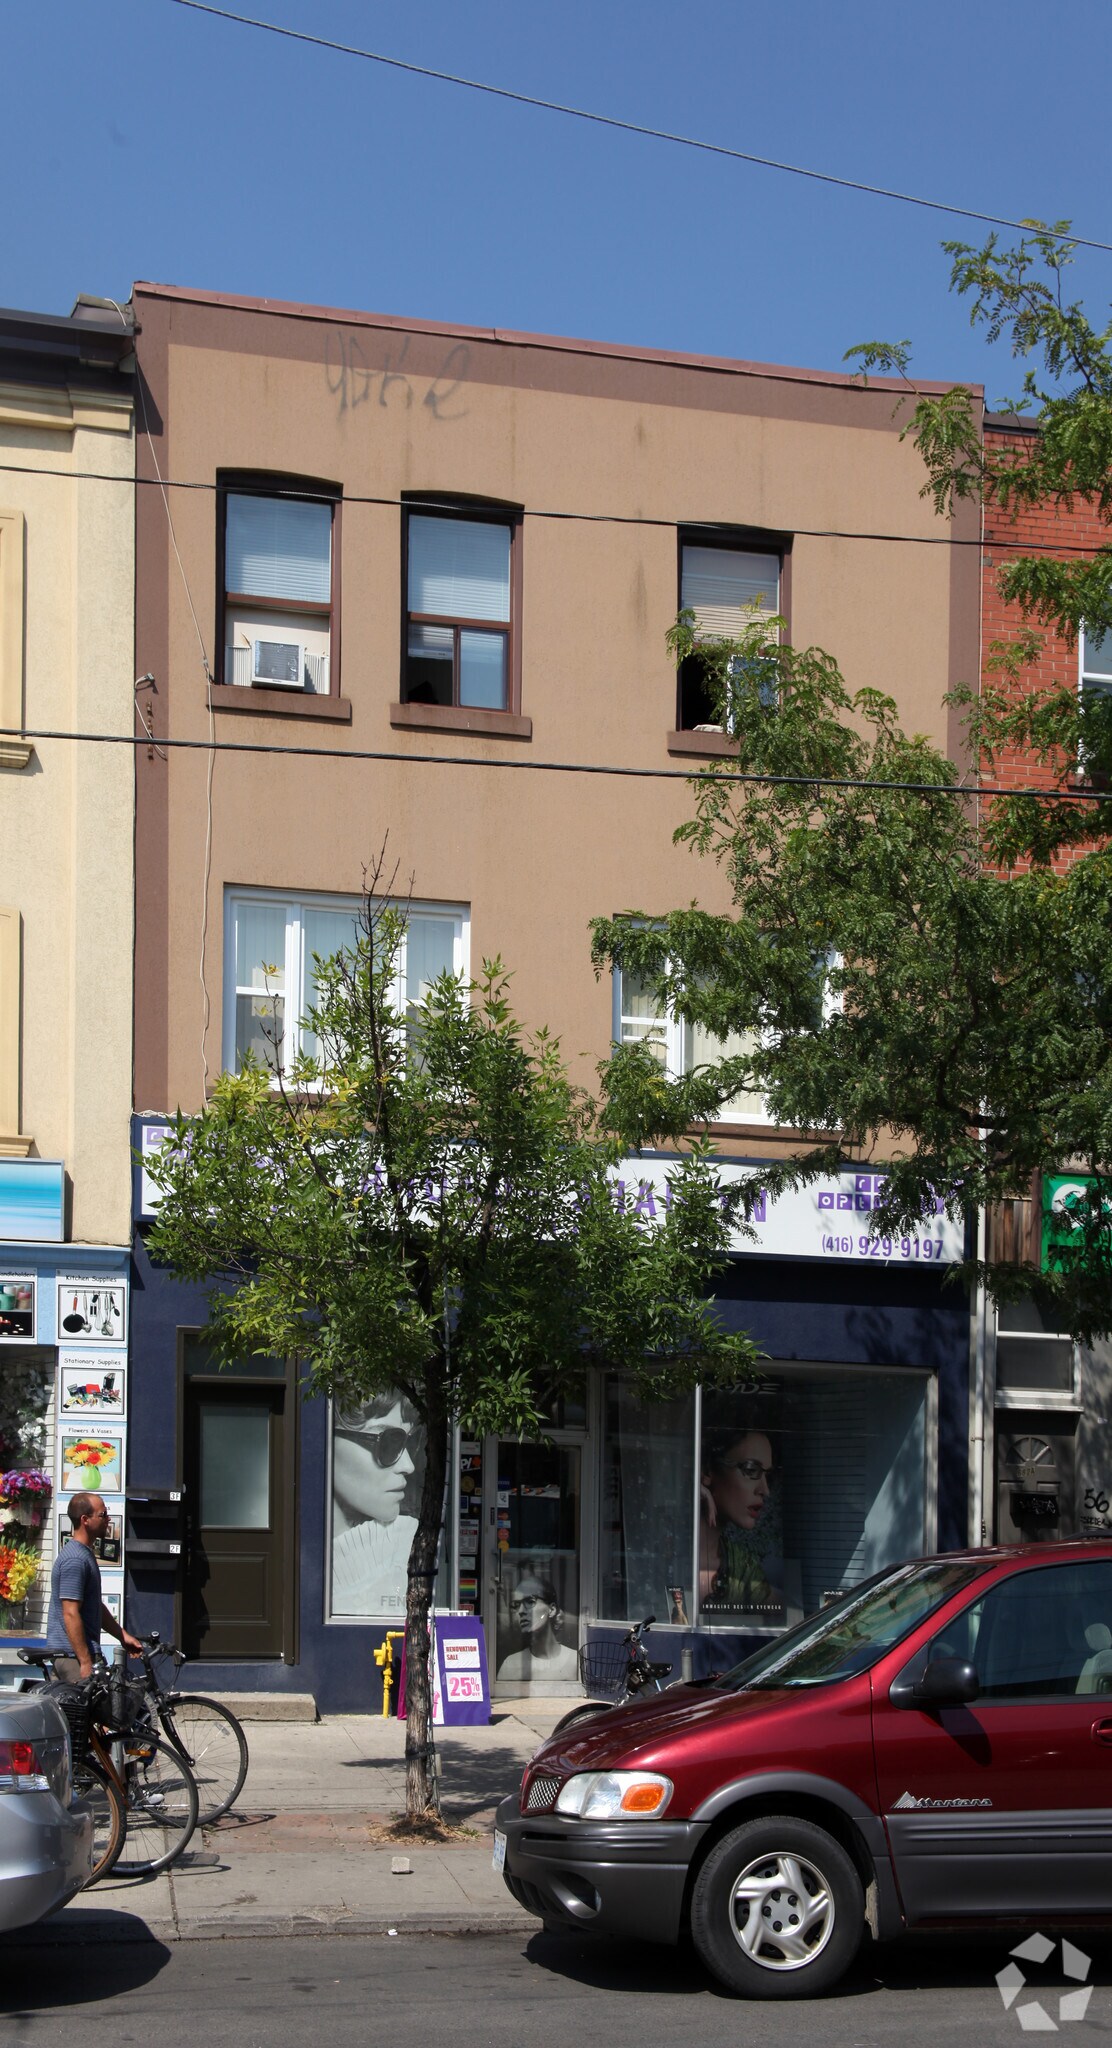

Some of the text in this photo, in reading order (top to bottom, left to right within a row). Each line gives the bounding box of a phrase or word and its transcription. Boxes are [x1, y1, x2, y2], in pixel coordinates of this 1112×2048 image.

[822, 1234, 944, 1260] (416) 929-9197
[170, 1545, 180, 1553] 2F
[381, 1595, 406, 1608] FEN
[445, 1645, 478, 1653] RENOVATION
[449, 1676, 480, 1697] 25%
[915, 1797, 993, 1809] Montana
